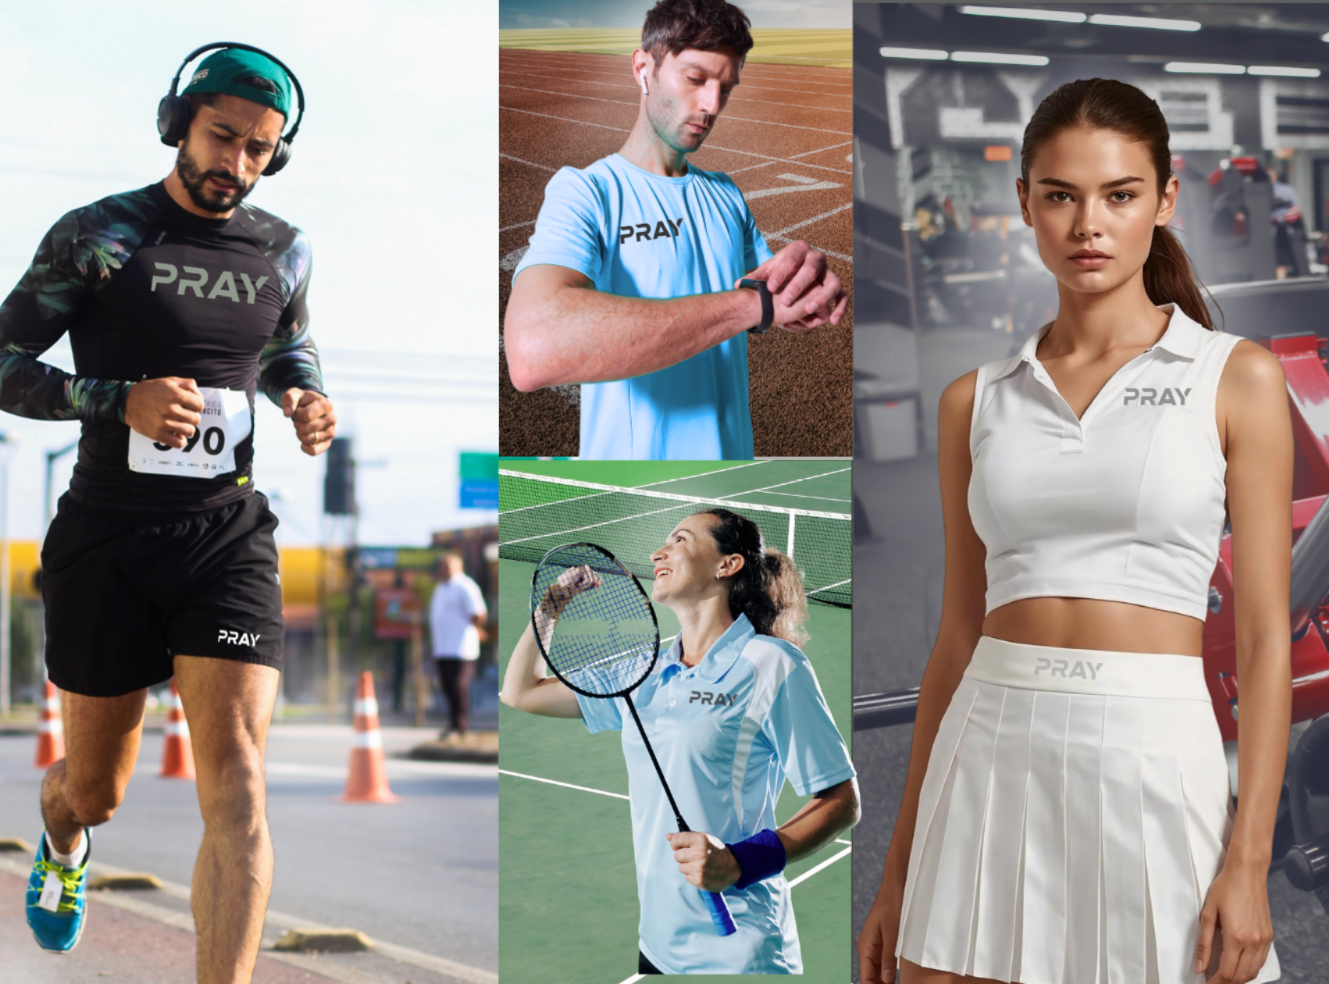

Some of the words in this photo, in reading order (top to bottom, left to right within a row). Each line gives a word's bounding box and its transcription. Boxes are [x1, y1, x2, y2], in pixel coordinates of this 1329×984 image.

[619, 217, 683, 244] PRAY
[151, 262, 269, 304] PRAY
[1123, 387, 1192, 406] PRAY
[200, 407, 222, 417] RCITO
[218, 629, 261, 647] PRAY
[1034, 657, 1104, 680] PRAY
[689, 690, 739, 706] PRAY
